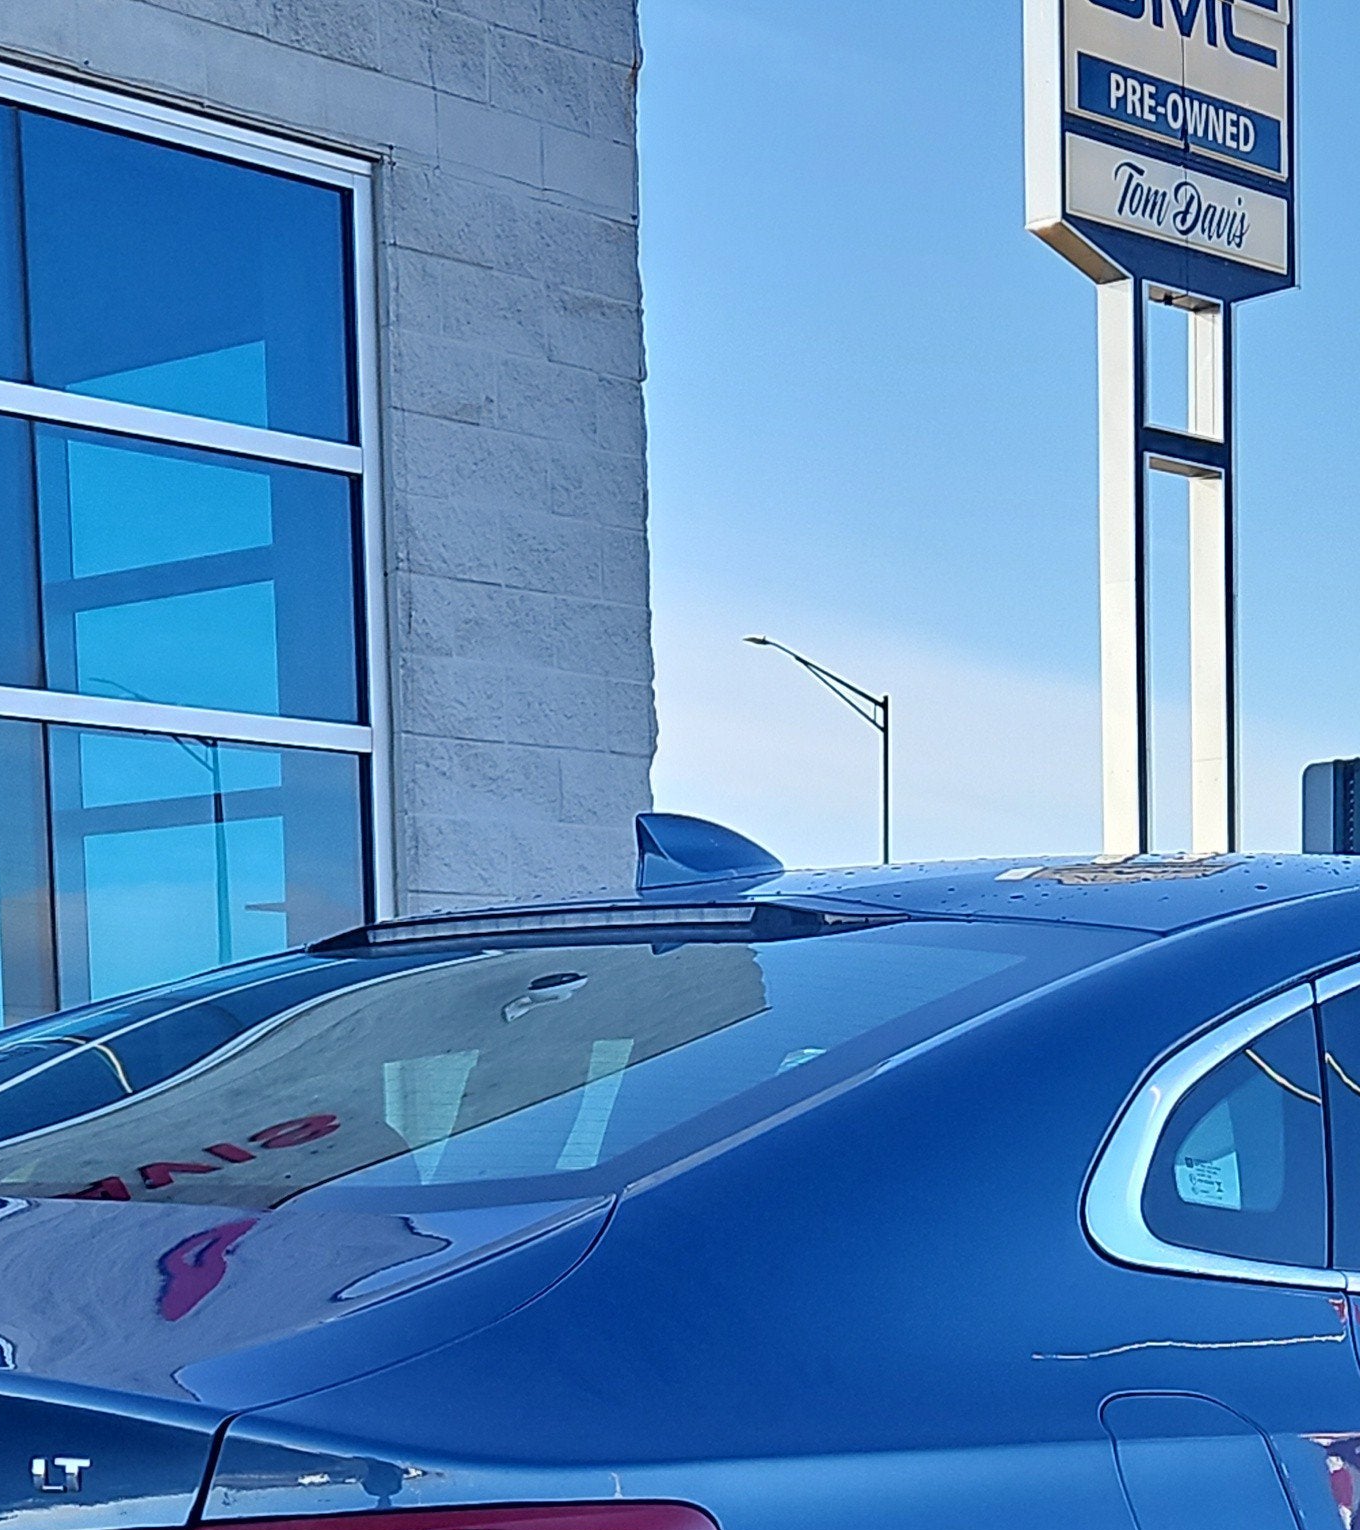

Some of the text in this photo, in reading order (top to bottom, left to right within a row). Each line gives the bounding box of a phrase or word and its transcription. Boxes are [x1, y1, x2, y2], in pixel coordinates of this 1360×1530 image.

[1110, 72, 1255, 152] PRE-OWNED
[1114, 161, 1251, 249] Tom Davis
[31, 1457, 91, 1493] LT
